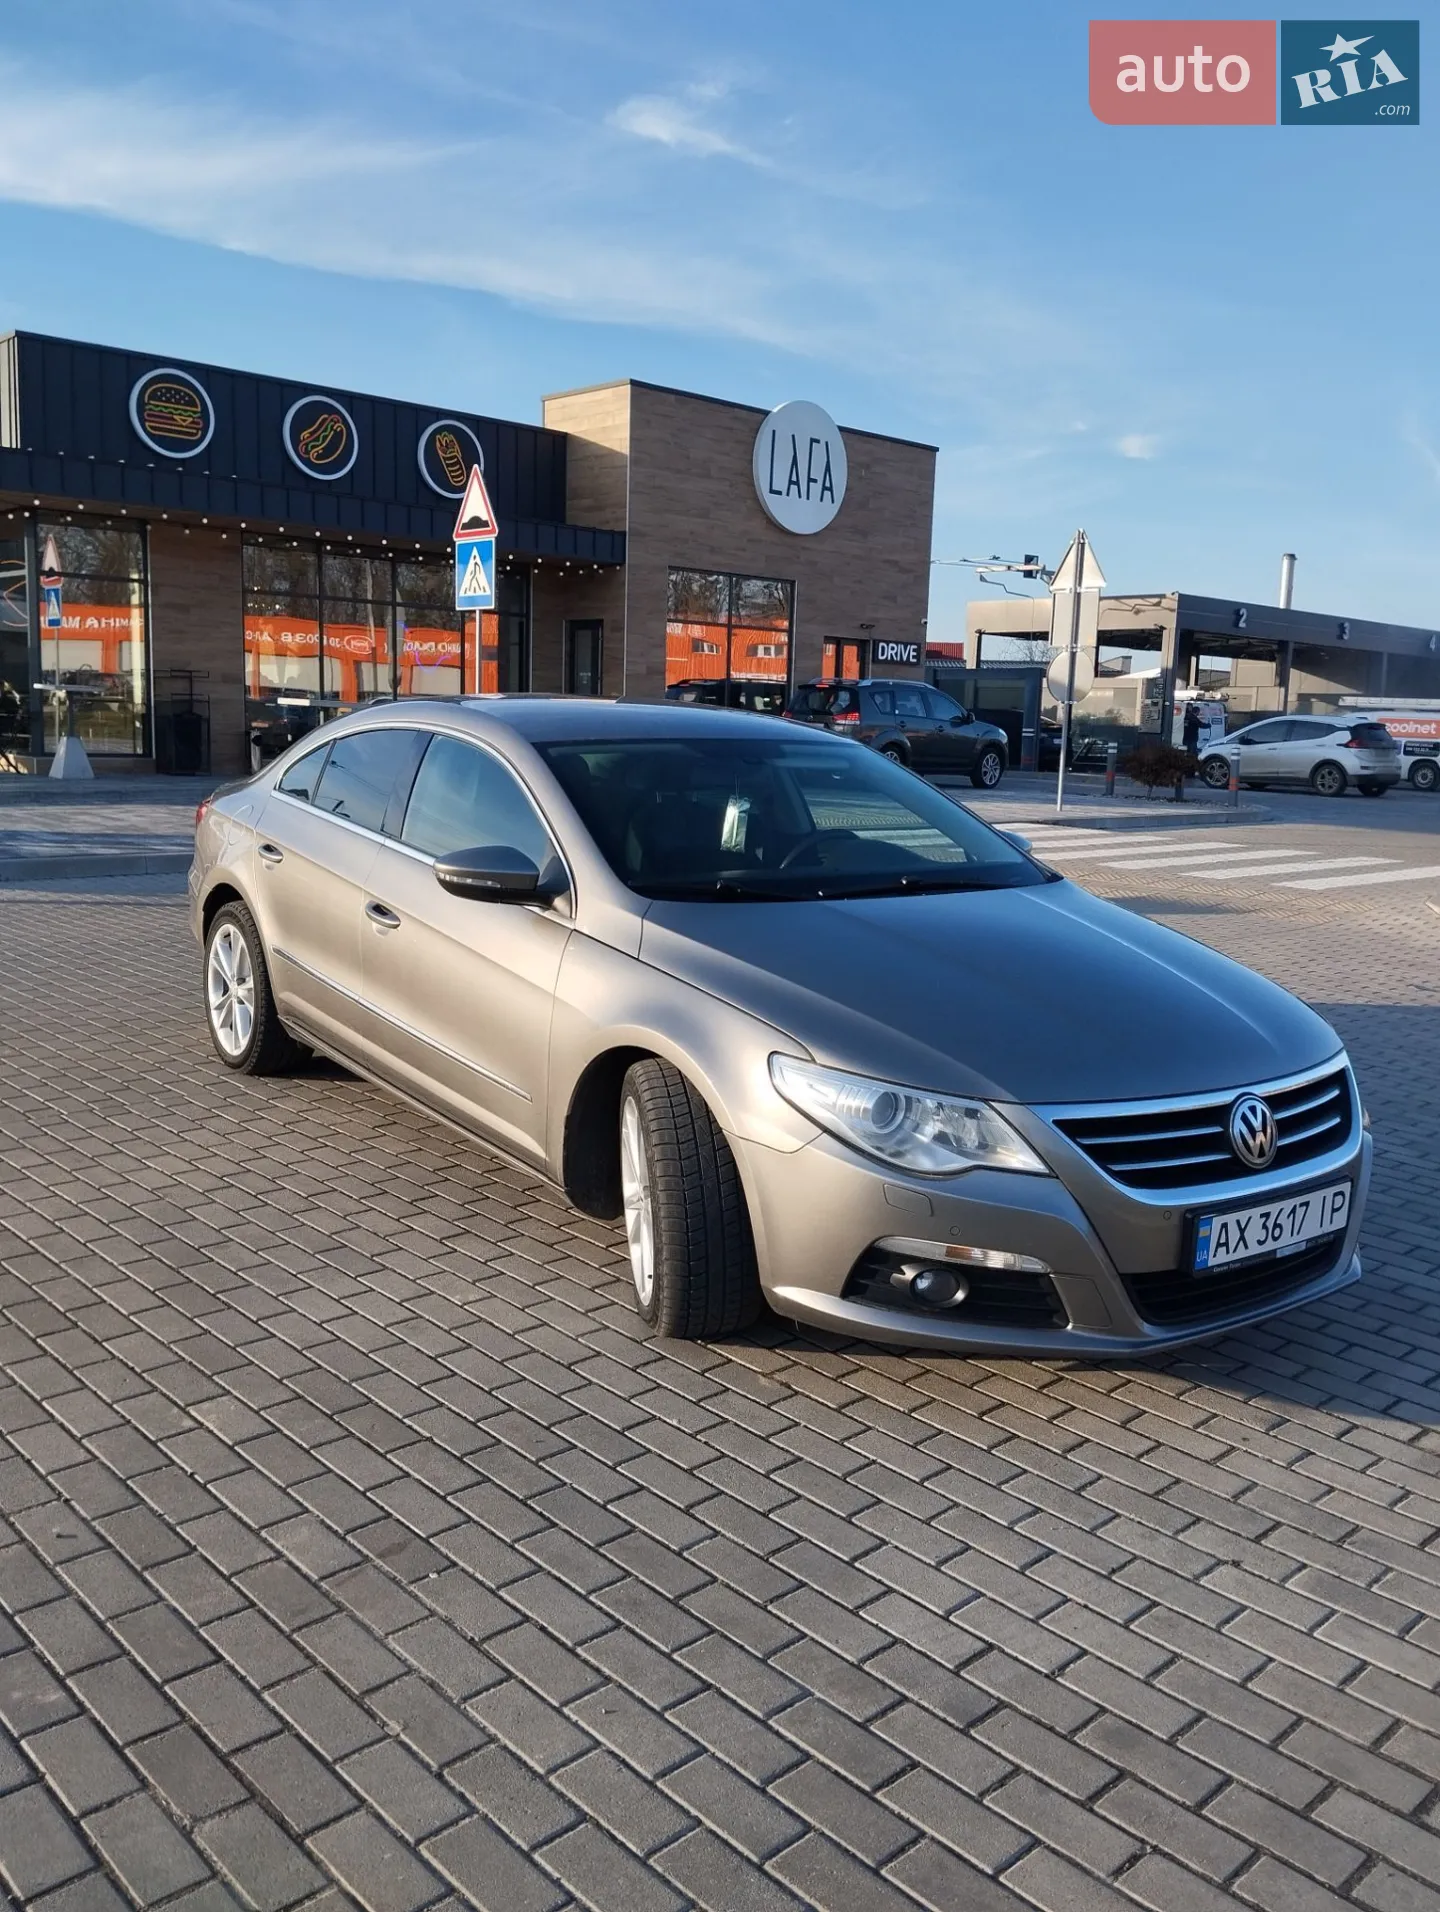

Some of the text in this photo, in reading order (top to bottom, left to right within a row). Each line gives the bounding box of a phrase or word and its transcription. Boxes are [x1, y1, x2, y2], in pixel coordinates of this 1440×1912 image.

[768, 429, 835, 505] LAFA
[1239, 607, 1248, 628] 2
[1343, 621, 1350, 640] 3
[877, 641, 918, 664] DRIVE
[1429, 634, 1436, 652] 4
[1386, 721, 1437, 735] coolnet
[1213, 1190, 1346, 1259] AX 3617 IP
[1196, 1250, 1209, 1262] UA
